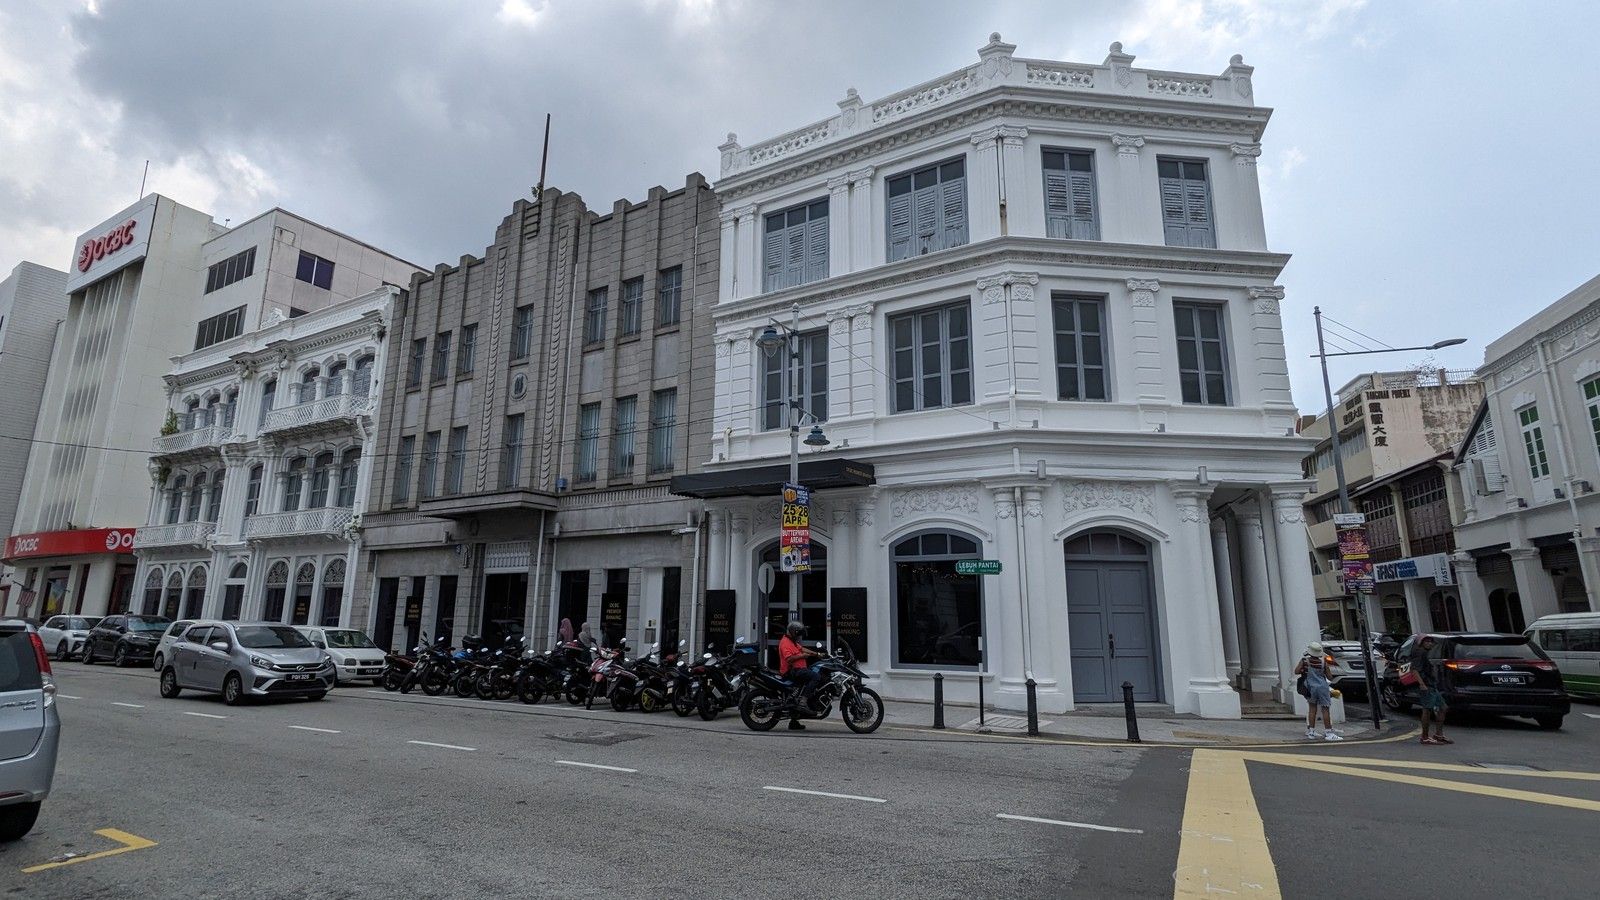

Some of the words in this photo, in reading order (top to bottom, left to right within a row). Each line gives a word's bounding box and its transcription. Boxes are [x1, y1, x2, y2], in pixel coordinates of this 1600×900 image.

[93, 220, 136, 261] OCBC
[785, 515, 802, 525] APR
[20, 537, 39, 552] OCBC
[790, 536, 803, 544] ARENA
